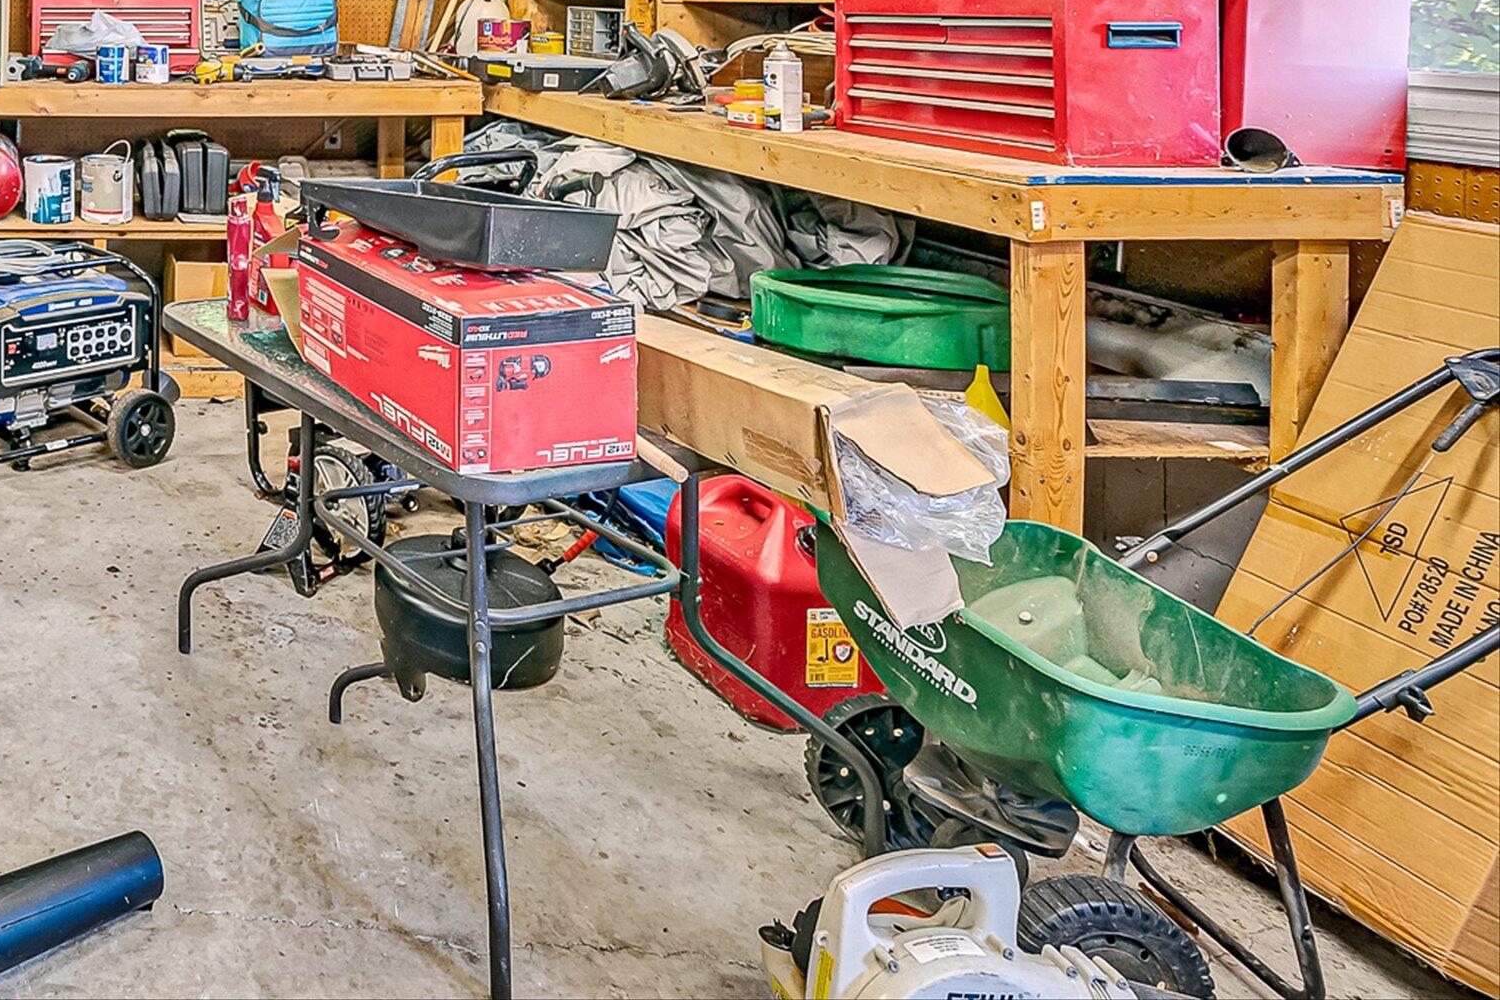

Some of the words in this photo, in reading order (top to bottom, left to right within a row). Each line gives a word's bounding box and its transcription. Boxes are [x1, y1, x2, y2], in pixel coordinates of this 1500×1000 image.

[370, 392, 427, 441] FUEL
[537, 447, 604, 462] FUEL
[1379, 522, 1408, 556] TSD
[1462, 531, 1500, 582] CHINA
[1398, 556, 1450, 635] PO#78520
[1453, 580, 1480, 601] IN
[810, 627, 850, 640] GASOLIN
[1428, 600, 1470, 649] MADE
[853, 599, 978, 704] STANDARD
